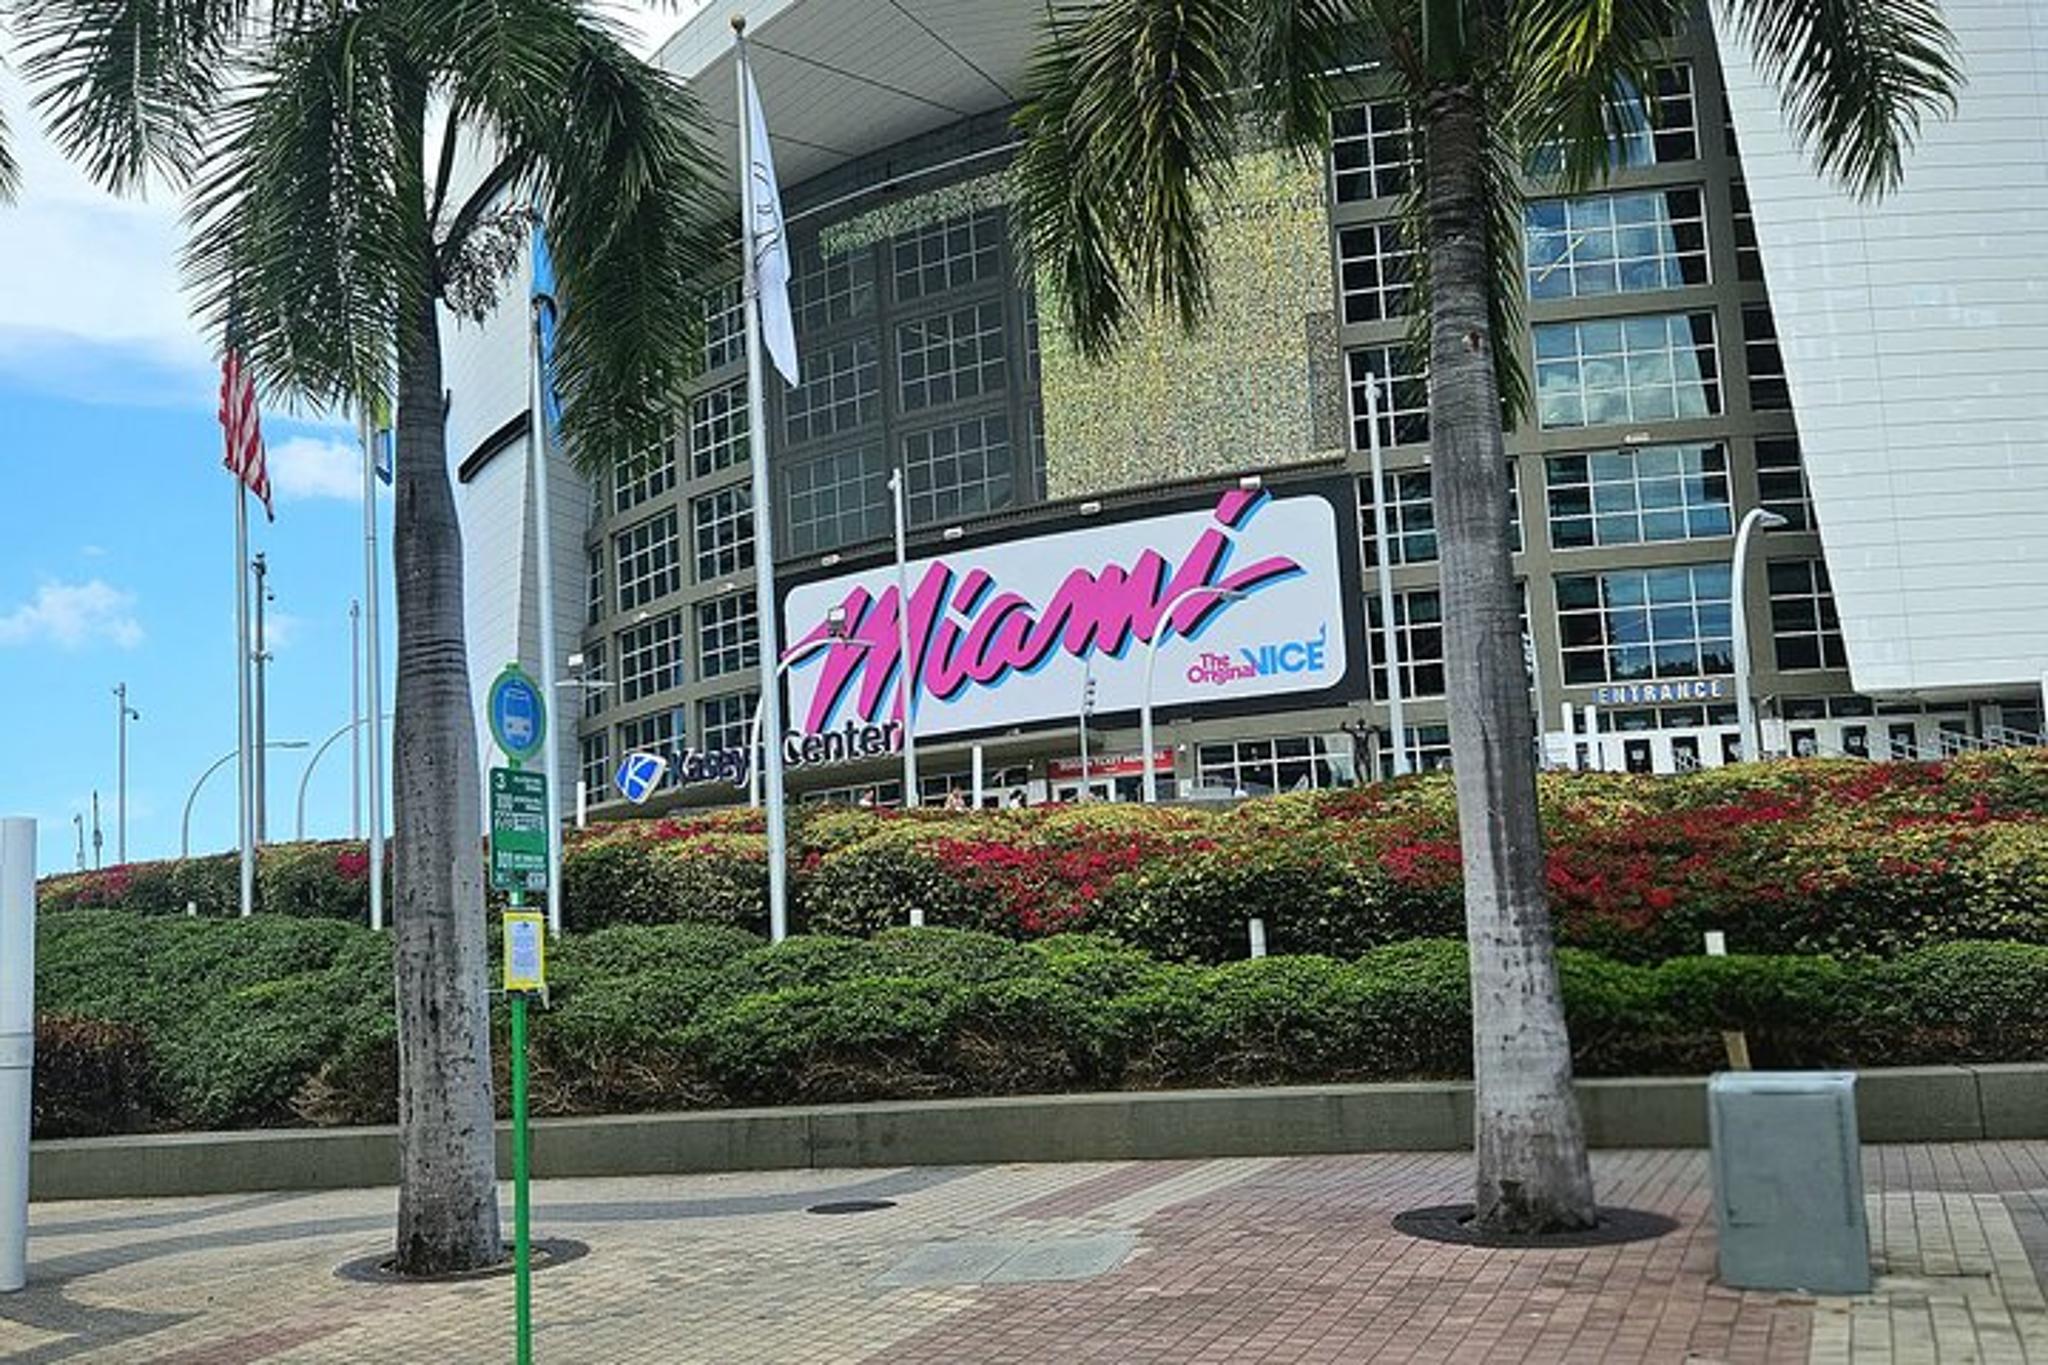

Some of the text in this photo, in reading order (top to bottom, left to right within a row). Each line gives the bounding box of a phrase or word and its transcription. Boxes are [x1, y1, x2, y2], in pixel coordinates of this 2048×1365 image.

[779, 489, 1306, 745] Miami
[1199, 653, 1230, 671] The
[1187, 664, 1256, 685] Original
[1597, 680, 1722, 704] ENTRANCE
[672, 748, 753, 788] Kasey
[781, 720, 902, 768] Center
